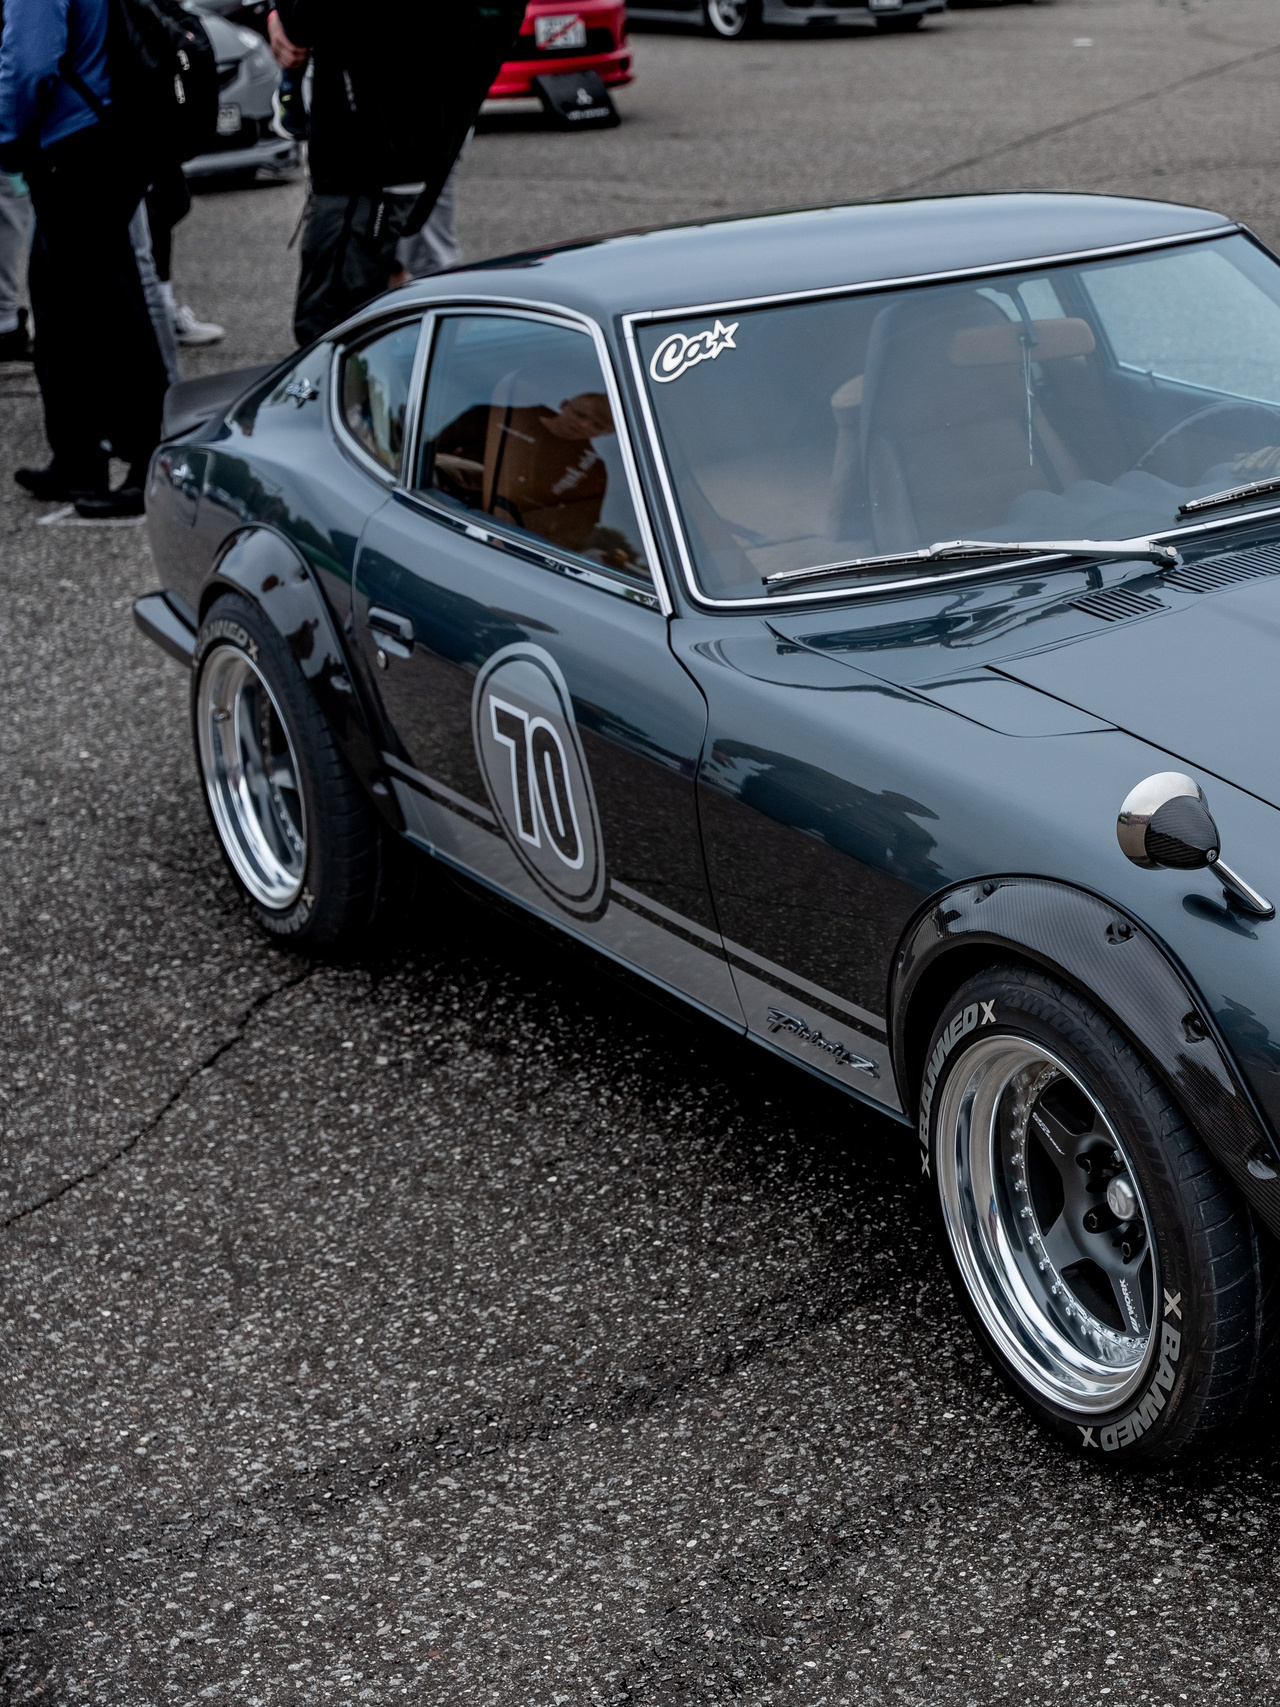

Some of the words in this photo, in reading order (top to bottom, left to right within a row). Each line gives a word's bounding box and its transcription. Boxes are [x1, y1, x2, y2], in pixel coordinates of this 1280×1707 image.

[488, 695, 585, 869] 70
[980, 999, 997, 1026] X
[919, 1003, 979, 1151] BANNED
[920, 1149, 931, 1179] X
[1163, 1287, 1182, 1320] X
[1101, 1320, 1182, 1452] BANNED
[1076, 1425, 1099, 1448] X
